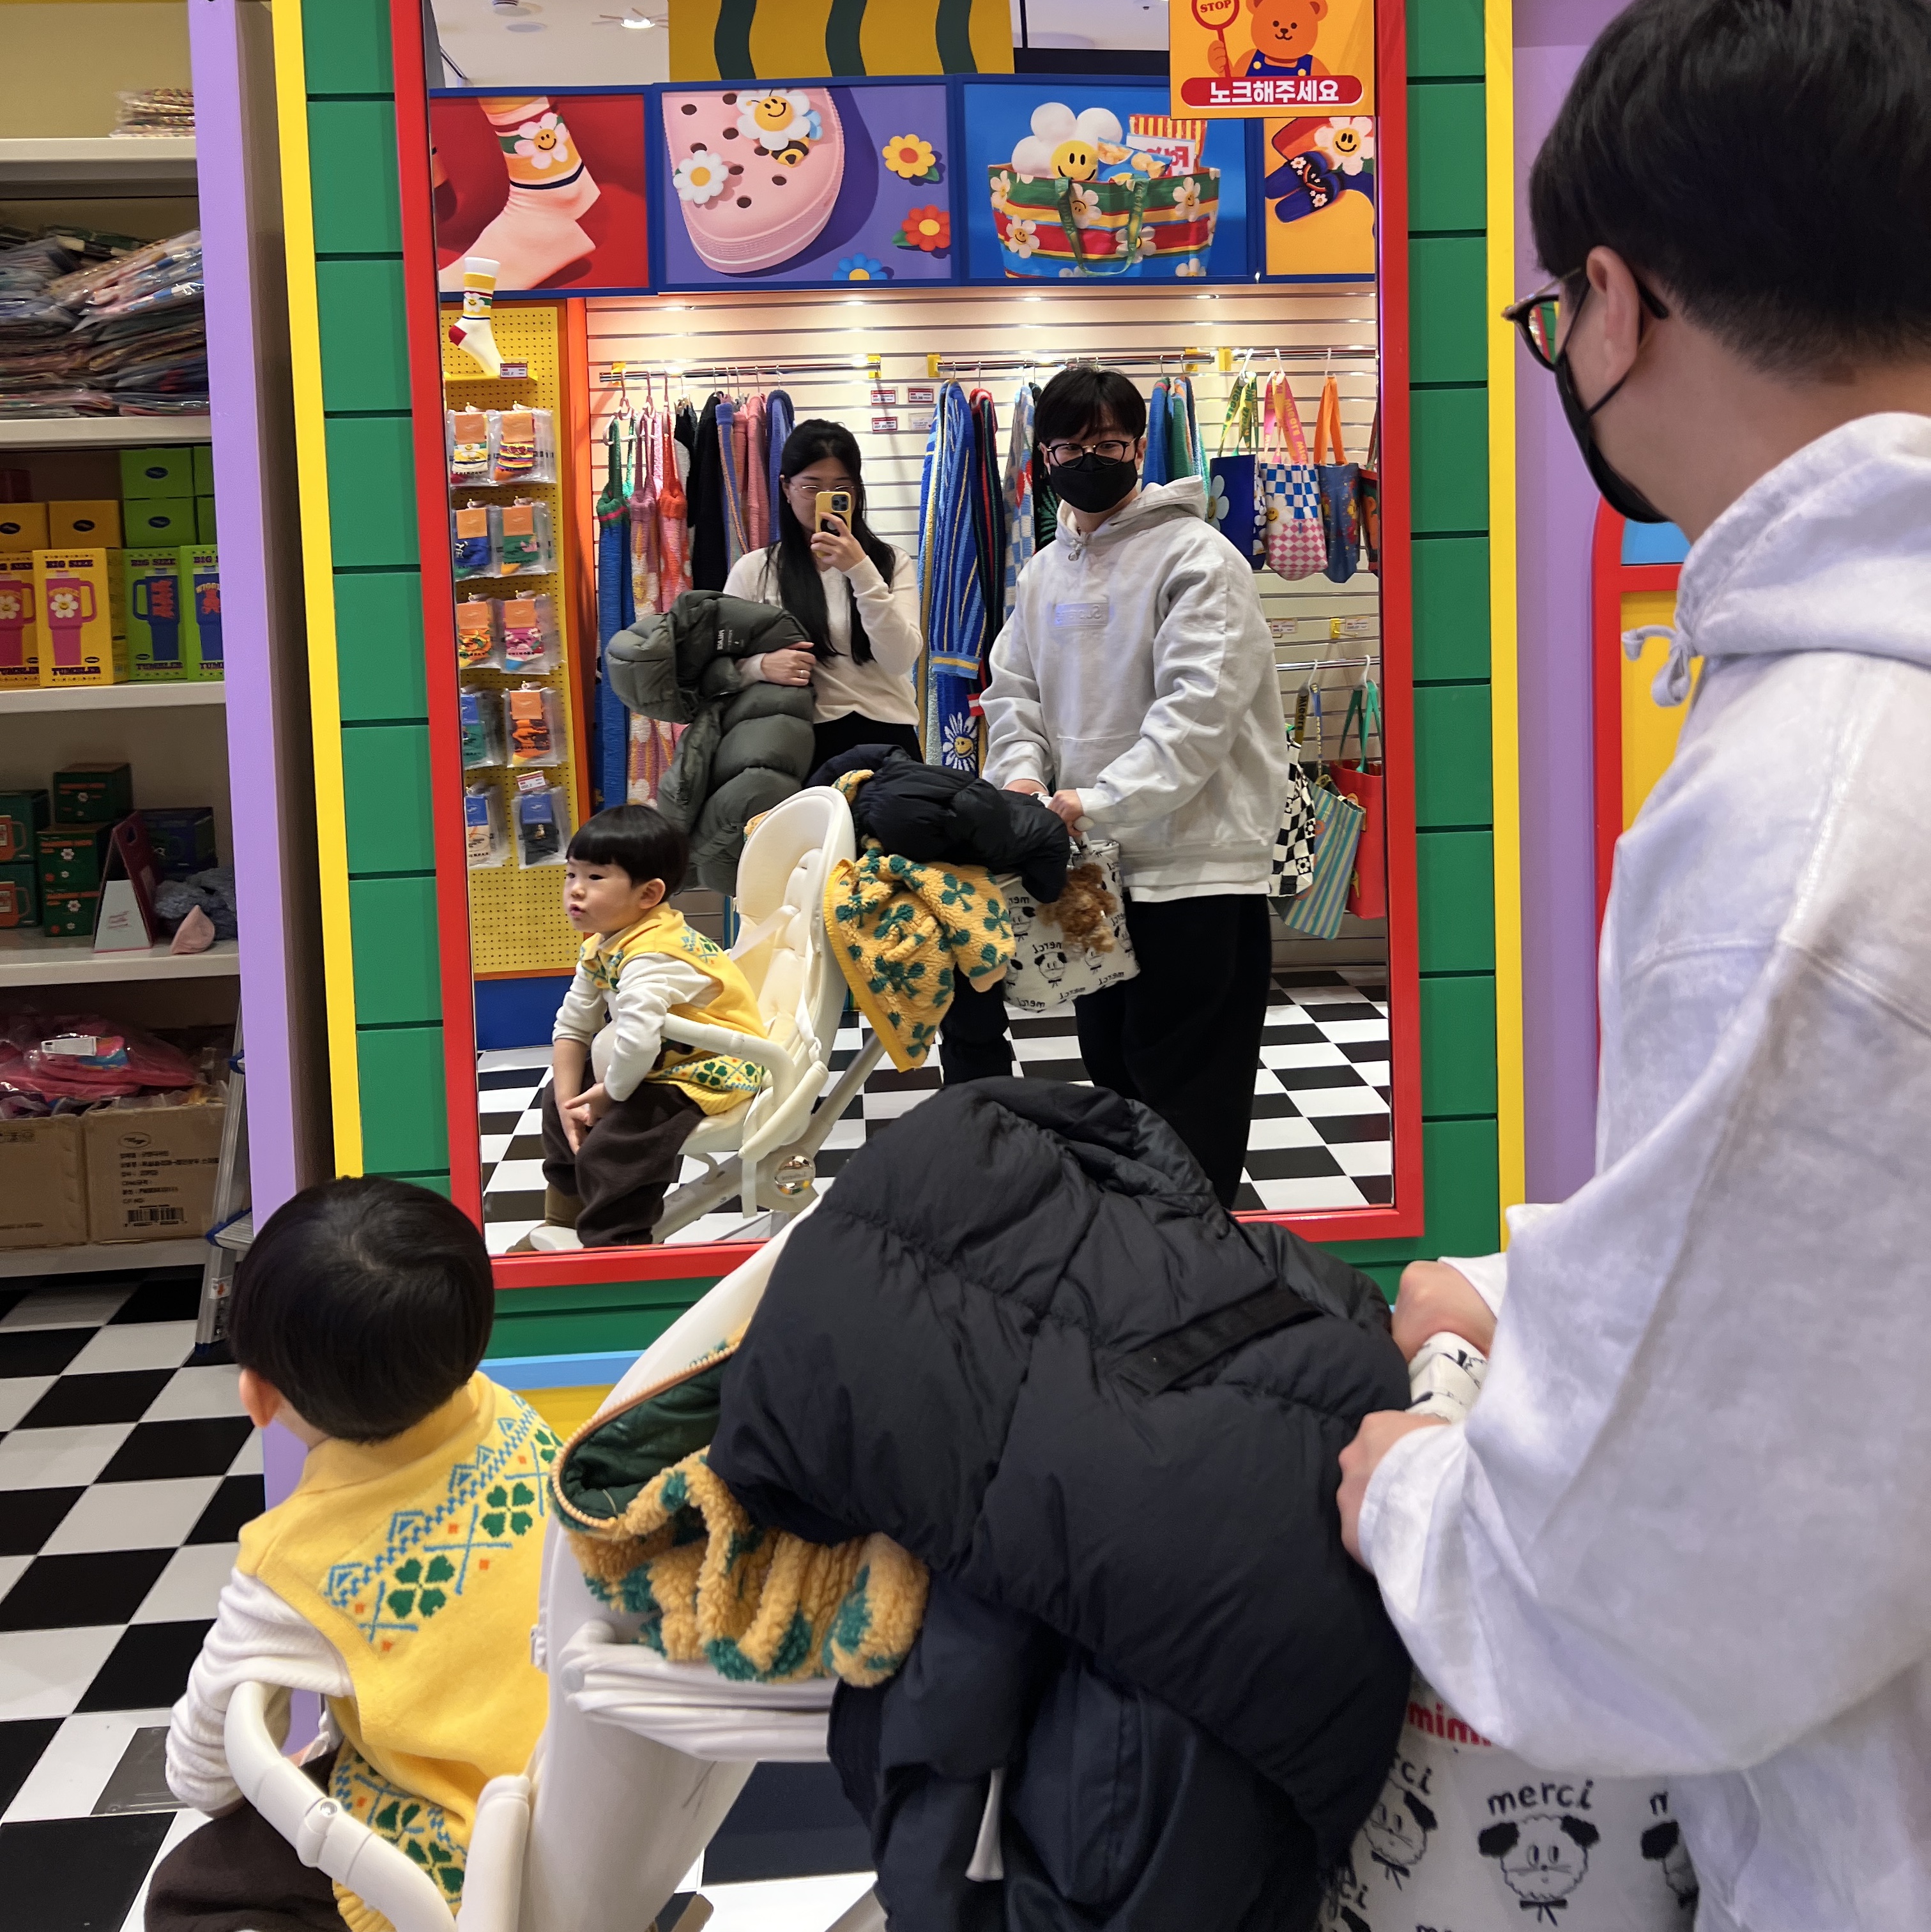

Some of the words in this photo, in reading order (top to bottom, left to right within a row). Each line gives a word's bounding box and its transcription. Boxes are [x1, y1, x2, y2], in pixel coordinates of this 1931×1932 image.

[1200, 0, 1232, 13] STOP
[1210, 80, 1339, 103] 노크해주세요
[1486, 1779, 1594, 1815] merci
